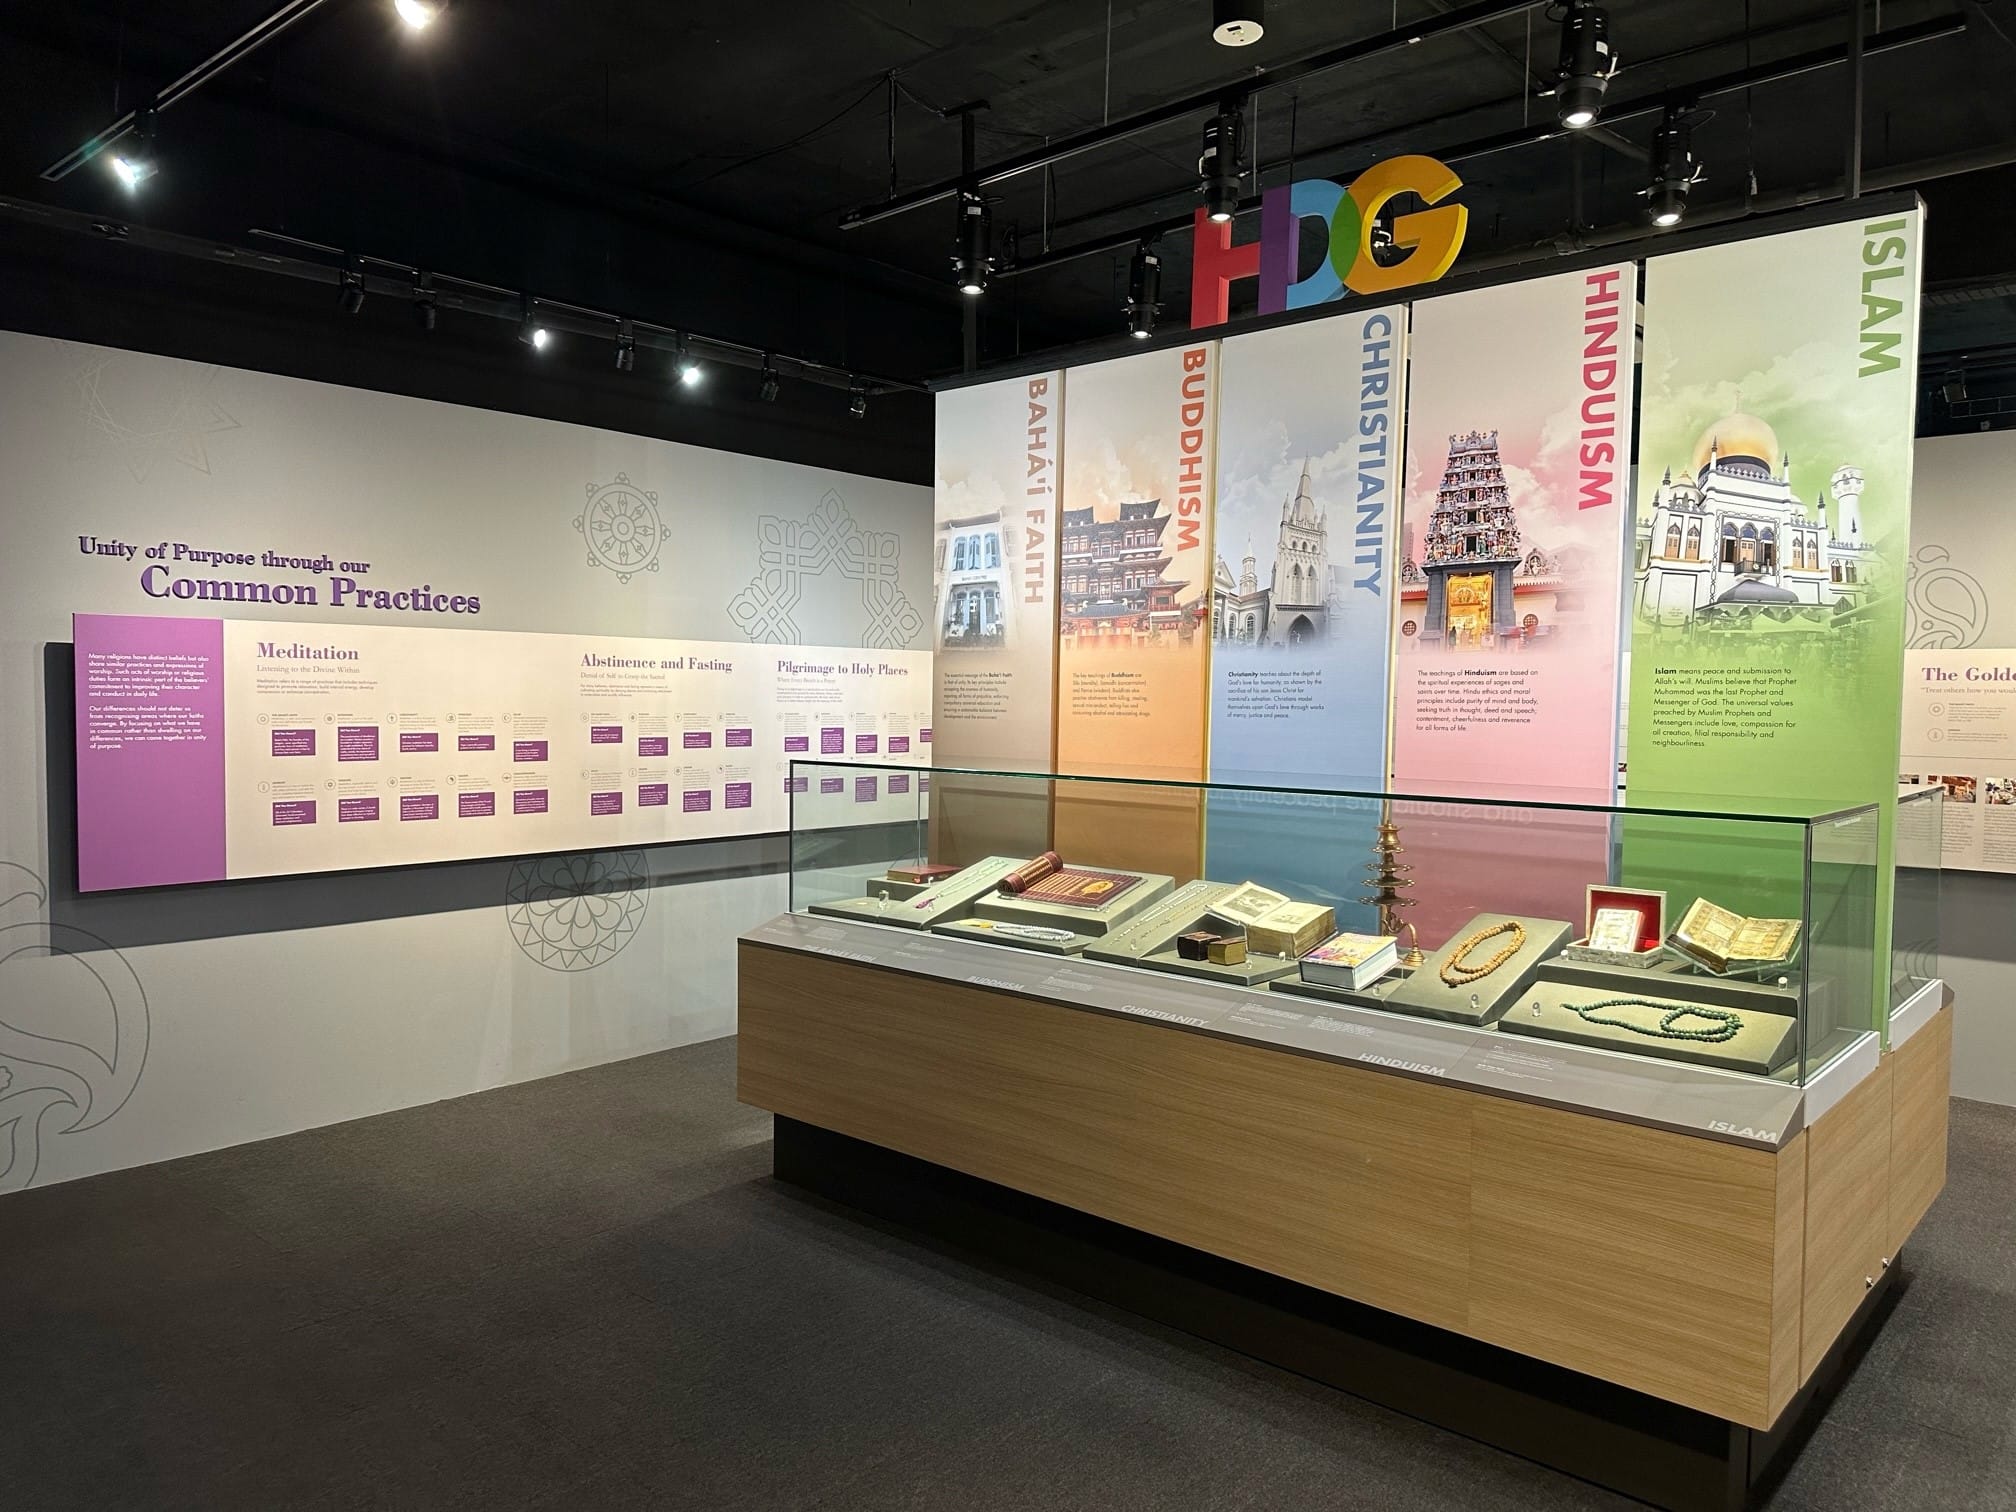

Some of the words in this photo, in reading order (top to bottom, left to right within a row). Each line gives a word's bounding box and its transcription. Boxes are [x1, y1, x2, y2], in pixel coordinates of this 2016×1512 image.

[1859, 218, 1906, 378] ISLAM
[1578, 271, 1620, 510] HINDUISM
[1177, 348, 1206, 552] BUDDHISM
[1354, 314, 1392, 597] CHRISTIANITY
[79, 536, 137, 561] Unity
[145, 542, 168, 559] of
[173, 543, 255, 567] Purpose
[262, 550, 334, 574] through
[340, 561, 370, 573] our
[1025, 510, 1045, 604] FAITH
[141, 565, 318, 605] Common
[330, 577, 480, 614] Practices
[257, 643, 359, 660] Meditation
[581, 654, 656, 669] Abstinence
[661, 657, 683, 670] and
[689, 657, 732, 672] Fasting
[778, 661, 835, 675] Pilgrimage
[839, 665, 848, 674] to
[852, 663, 875, 677] Holy
[879, 664, 908, 676] Places
[1768, 678, 1798, 687] Prophet
[1922, 667, 1958, 681] The
[1654, 698, 1690, 707] Messenger
[1740, 689, 1767, 698] Prophet
[1653, 708, 1685, 717] preached
[1687, 709, 1696, 718] by
[1725, 709, 1755, 718] Prophets
[1653, 718, 1692, 728] Messengers
[1722, 719, 1738, 728] love,
[1740, 720, 1784, 729] compassion
[1711, 730, 1758, 739] responsibility
[1121, 1005, 1208, 1026] CHRISTIANITY
[1359, 1052, 1446, 1077] HINDUISM
[1708, 1120, 1776, 1140] ISLAM
